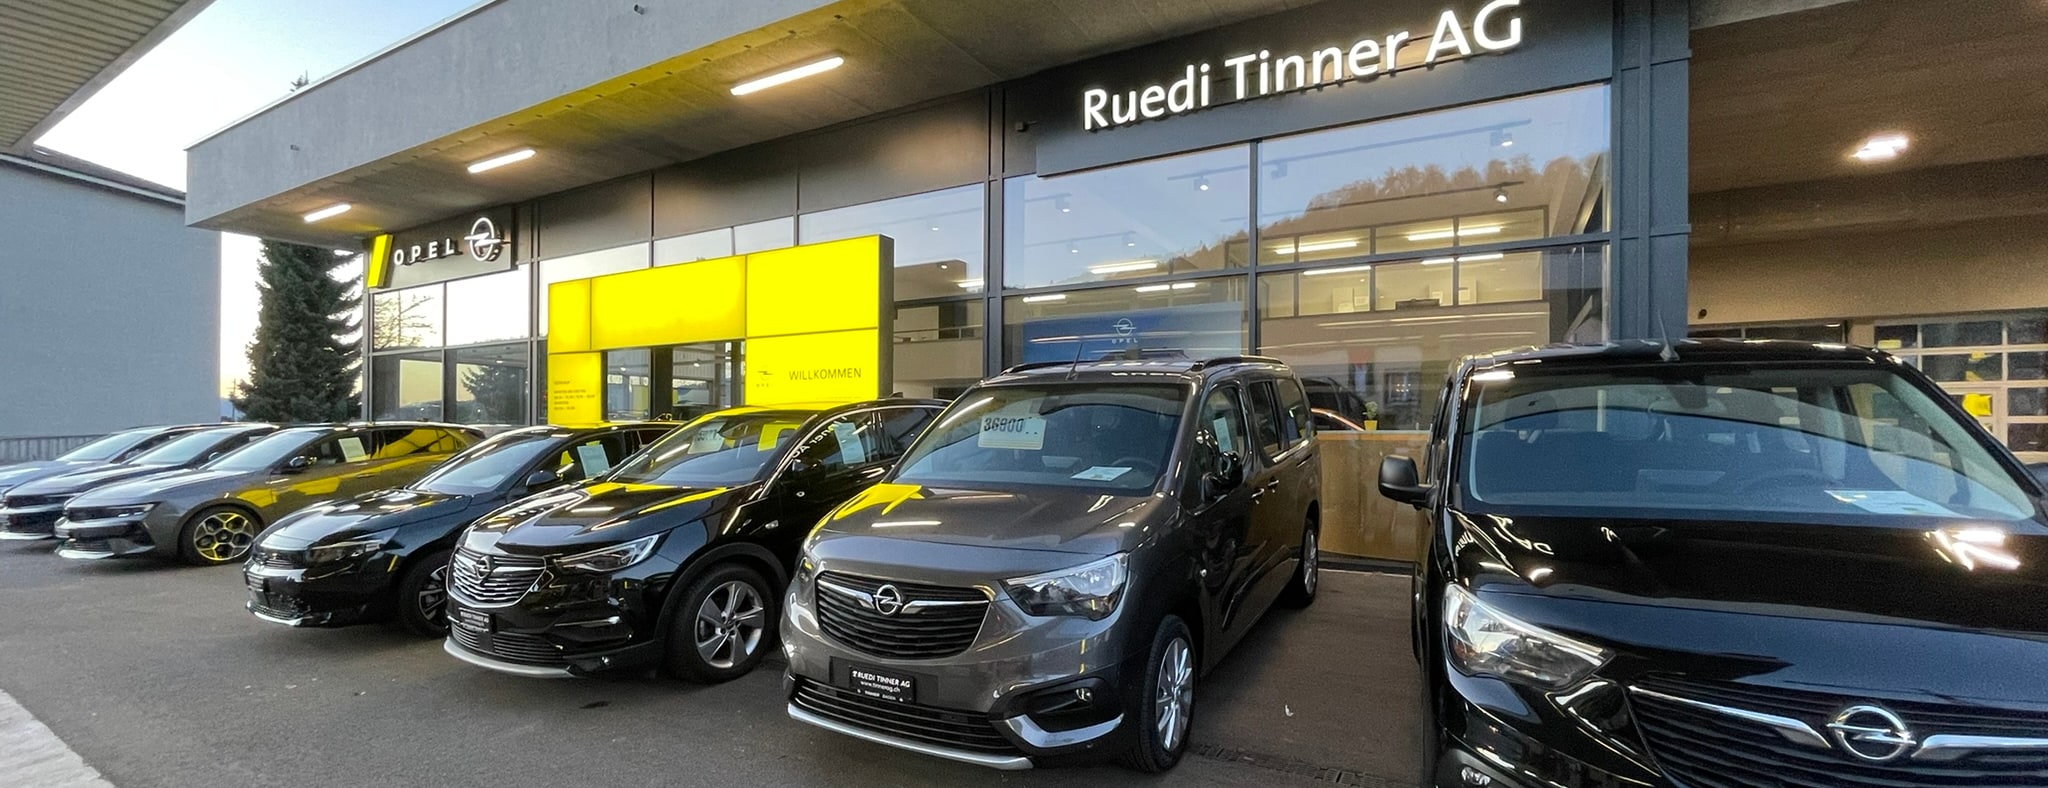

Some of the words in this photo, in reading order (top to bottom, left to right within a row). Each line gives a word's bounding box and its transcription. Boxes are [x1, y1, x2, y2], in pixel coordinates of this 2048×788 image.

[1083, 63, 1211, 131] Ruedi
[1224, 30, 1409, 101] Tinner
[1424, 0, 1522, 64] AG
[393, 238, 455, 265] OPEL
[788, 367, 862, 381] WILLKOMMEN
[876, 675, 899, 685] TINNER
